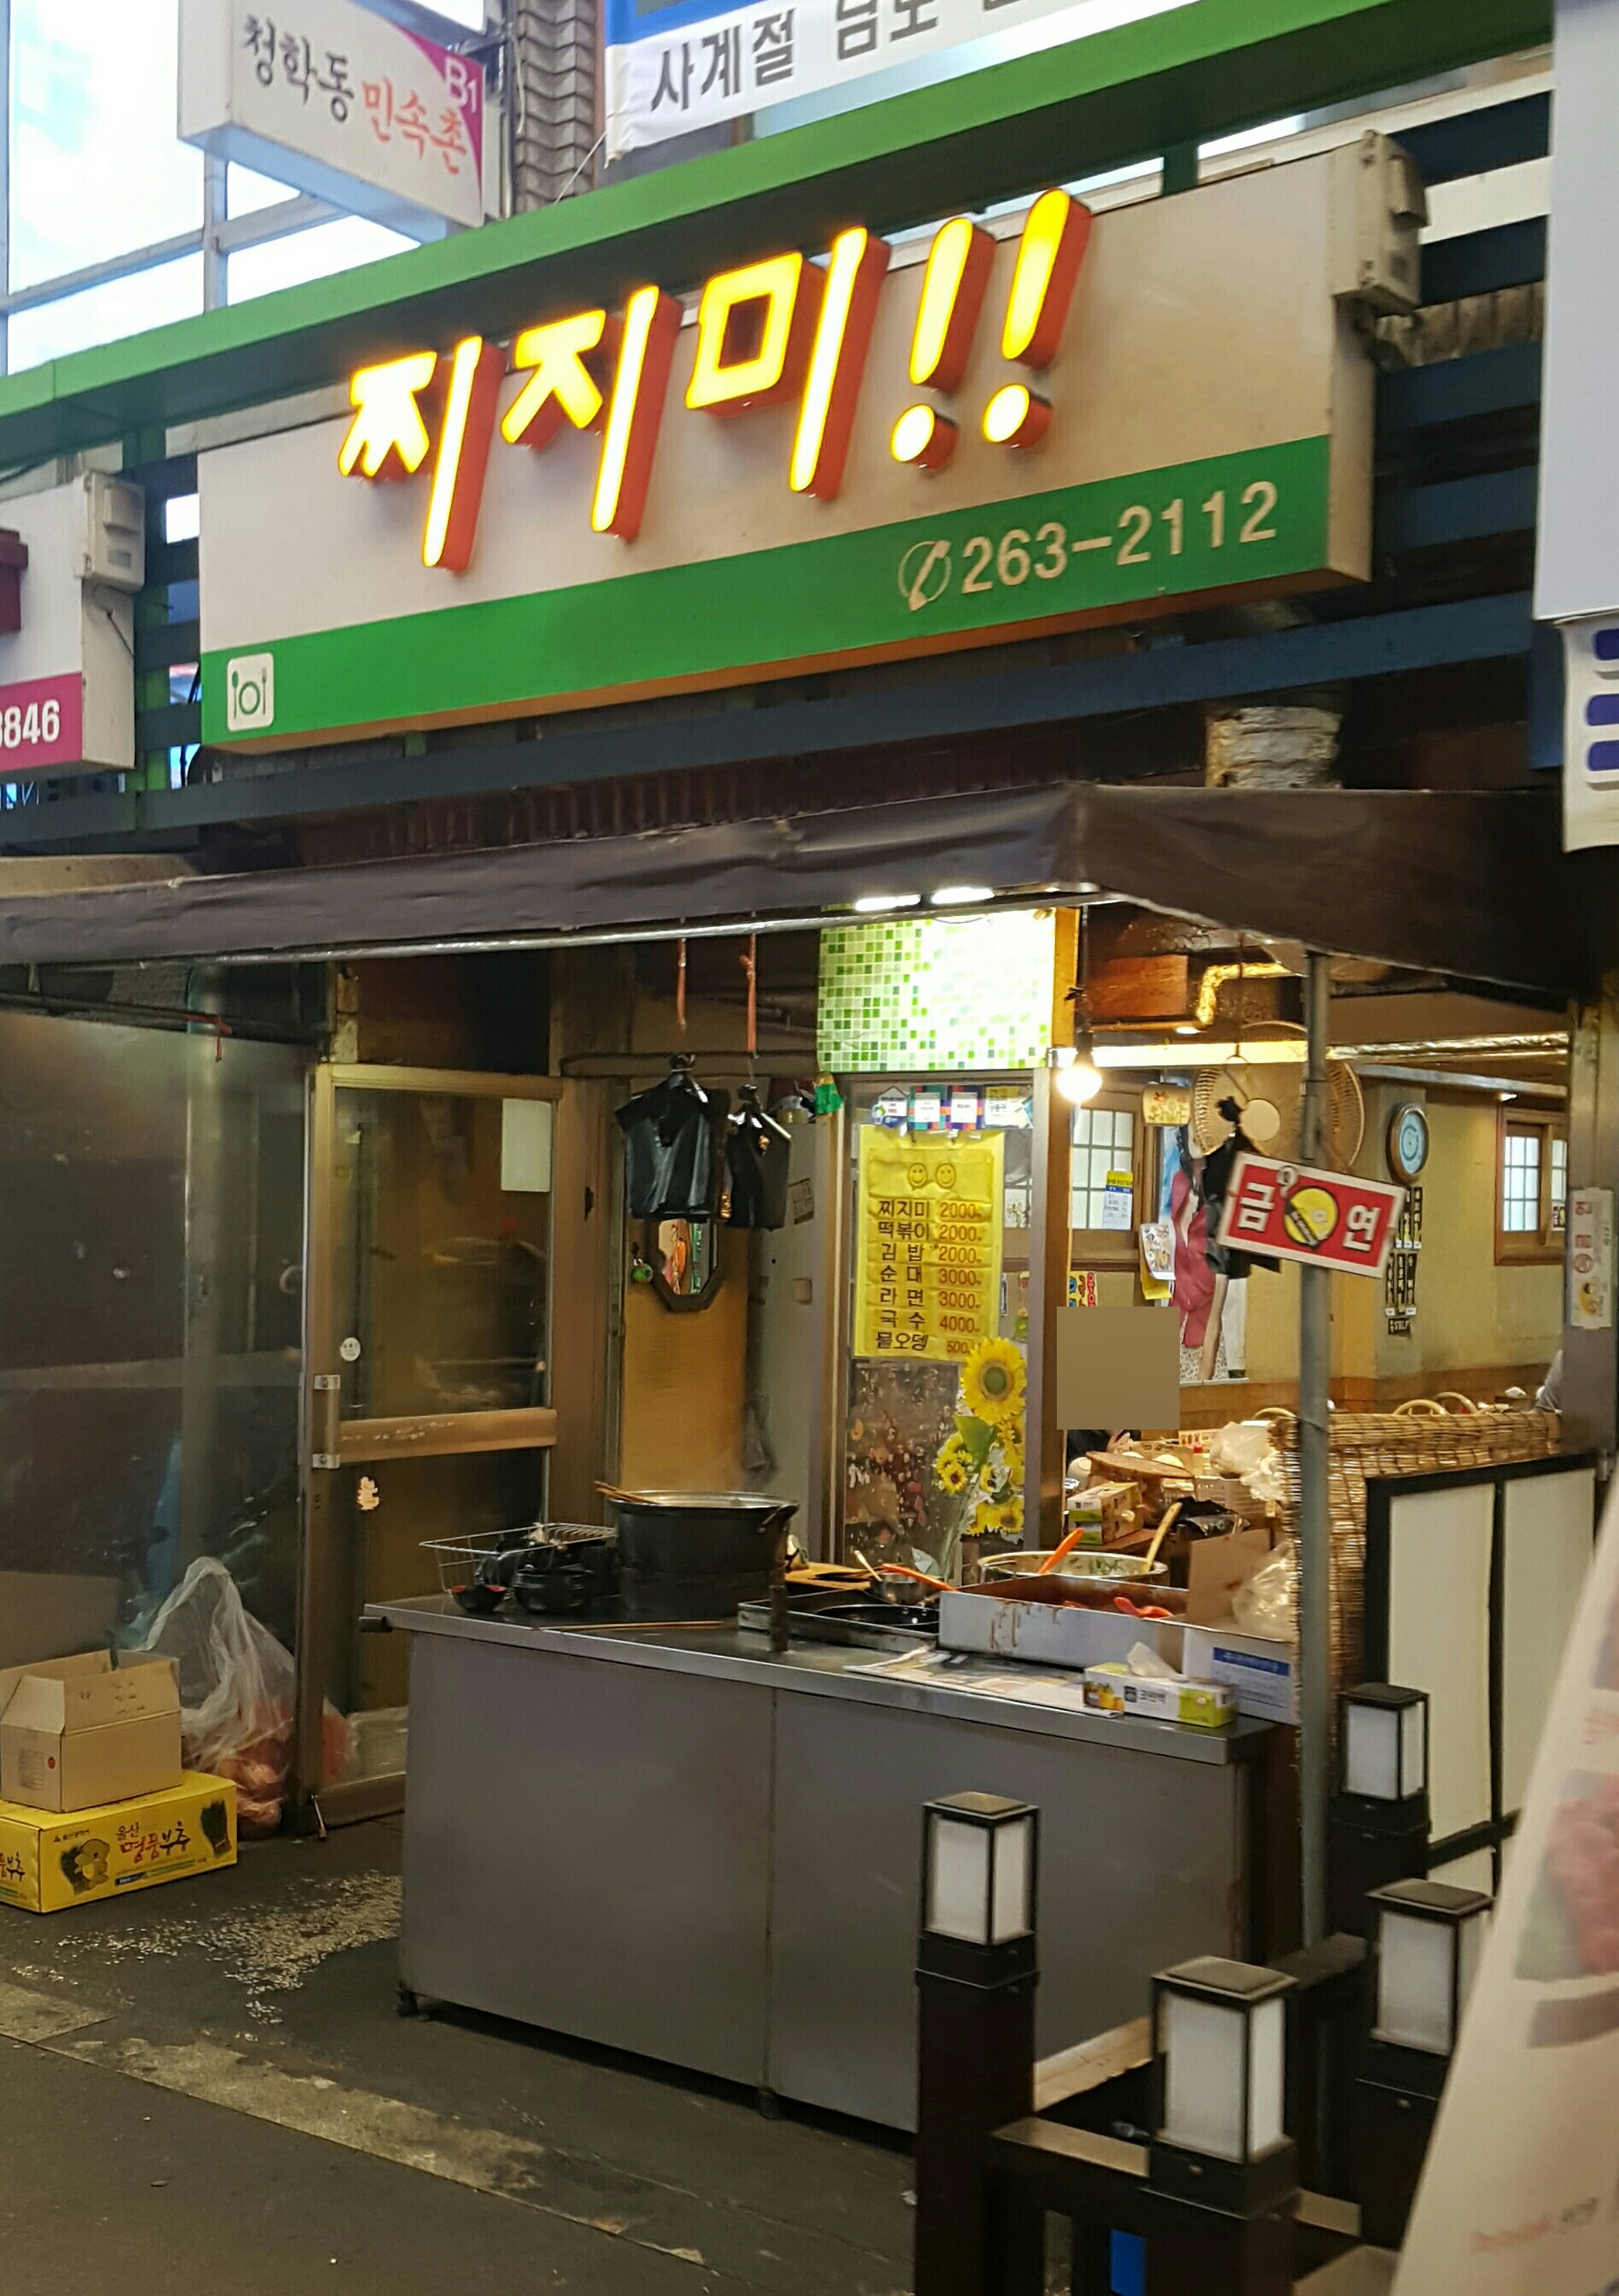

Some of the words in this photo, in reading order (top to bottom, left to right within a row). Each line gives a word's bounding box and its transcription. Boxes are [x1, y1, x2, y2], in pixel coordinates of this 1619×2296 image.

[444, 56, 478, 114] B1
[650, 9, 795, 112] 사계절
[244, 15, 355, 123] 청학동
[361, 76, 467, 174] 민속촌
[961, 480, 1278, 594] 263-2112
[0, 699, 60, 749] 846
[878, 1199, 930, 1218] 찌지미
[878, 1221, 930, 1241] 떡볶이
[1237, 1182, 1276, 1233] 금
[1342, 1204, 1381, 1252] 연
